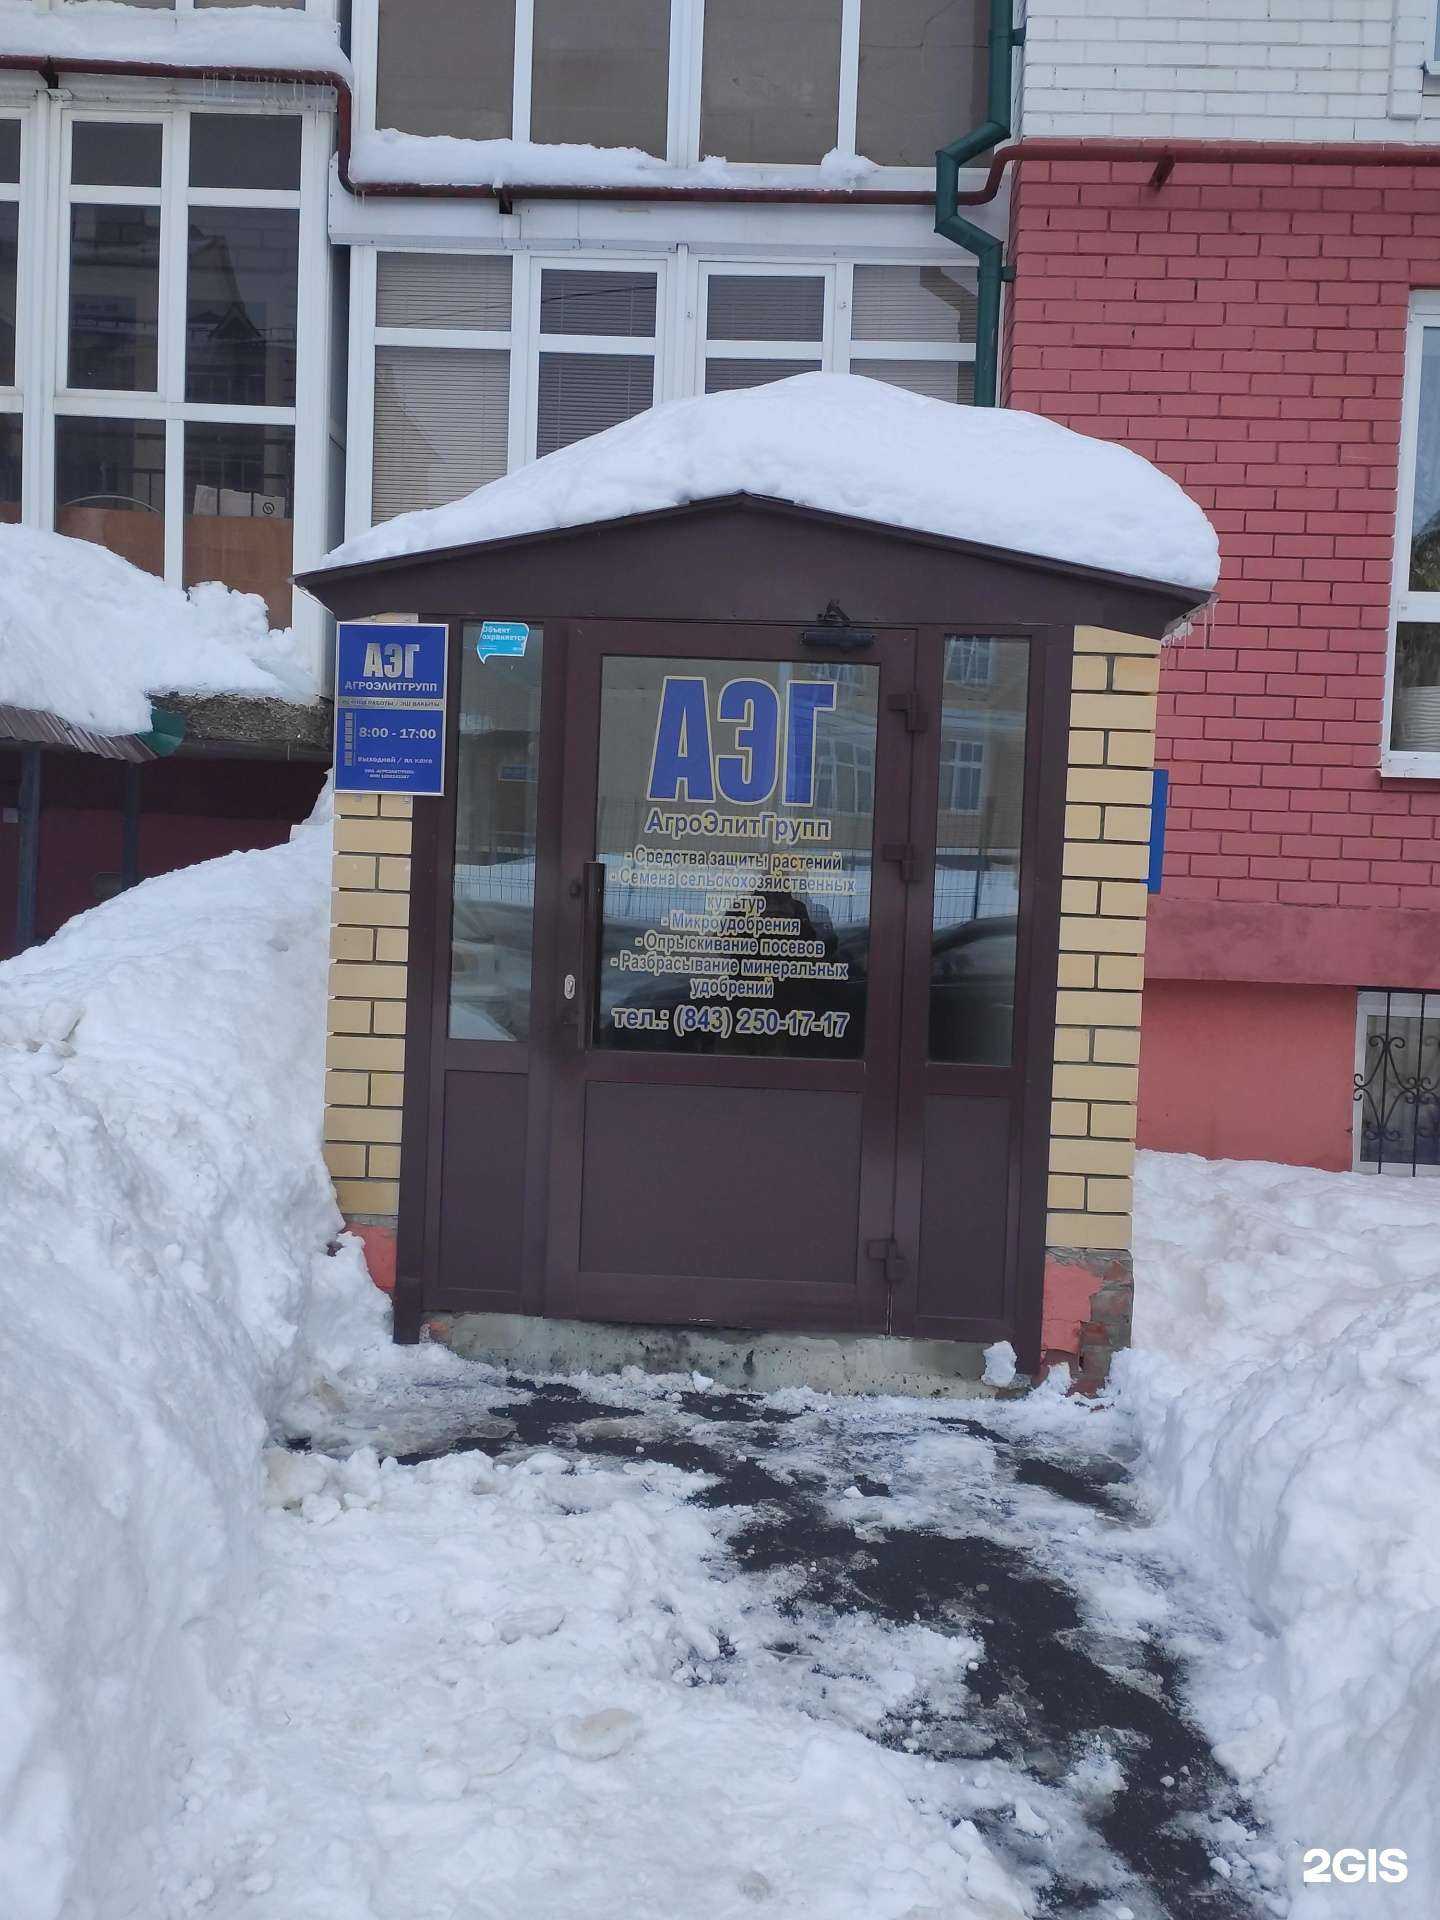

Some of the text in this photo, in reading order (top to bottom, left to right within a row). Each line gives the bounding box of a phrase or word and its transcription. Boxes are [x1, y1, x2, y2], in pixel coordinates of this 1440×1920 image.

[363, 642, 420, 679] АЭГ
[344, 681, 438, 693] АГРОЭЛИТГРУПП
[359, 727, 389, 739] 8:00
[399, 728, 437, 740] 17:00
[647, 675, 838, 807] АЭГ
[645, 807, 832, 843] АгроЭлитГрупп
[708, 850, 769, 870] защиты
[771, 851, 843, 875] растений
[679, 869, 857, 896] сельскохозяйственных
[706, 895, 767, 916] культур
[760, 939, 826, 958] посевов
[741, 959, 849, 981] минеральных
[690, 976, 774, 1000] удобрений
[611, 1005, 851, 1038] тел.: (843) 250-17-17
